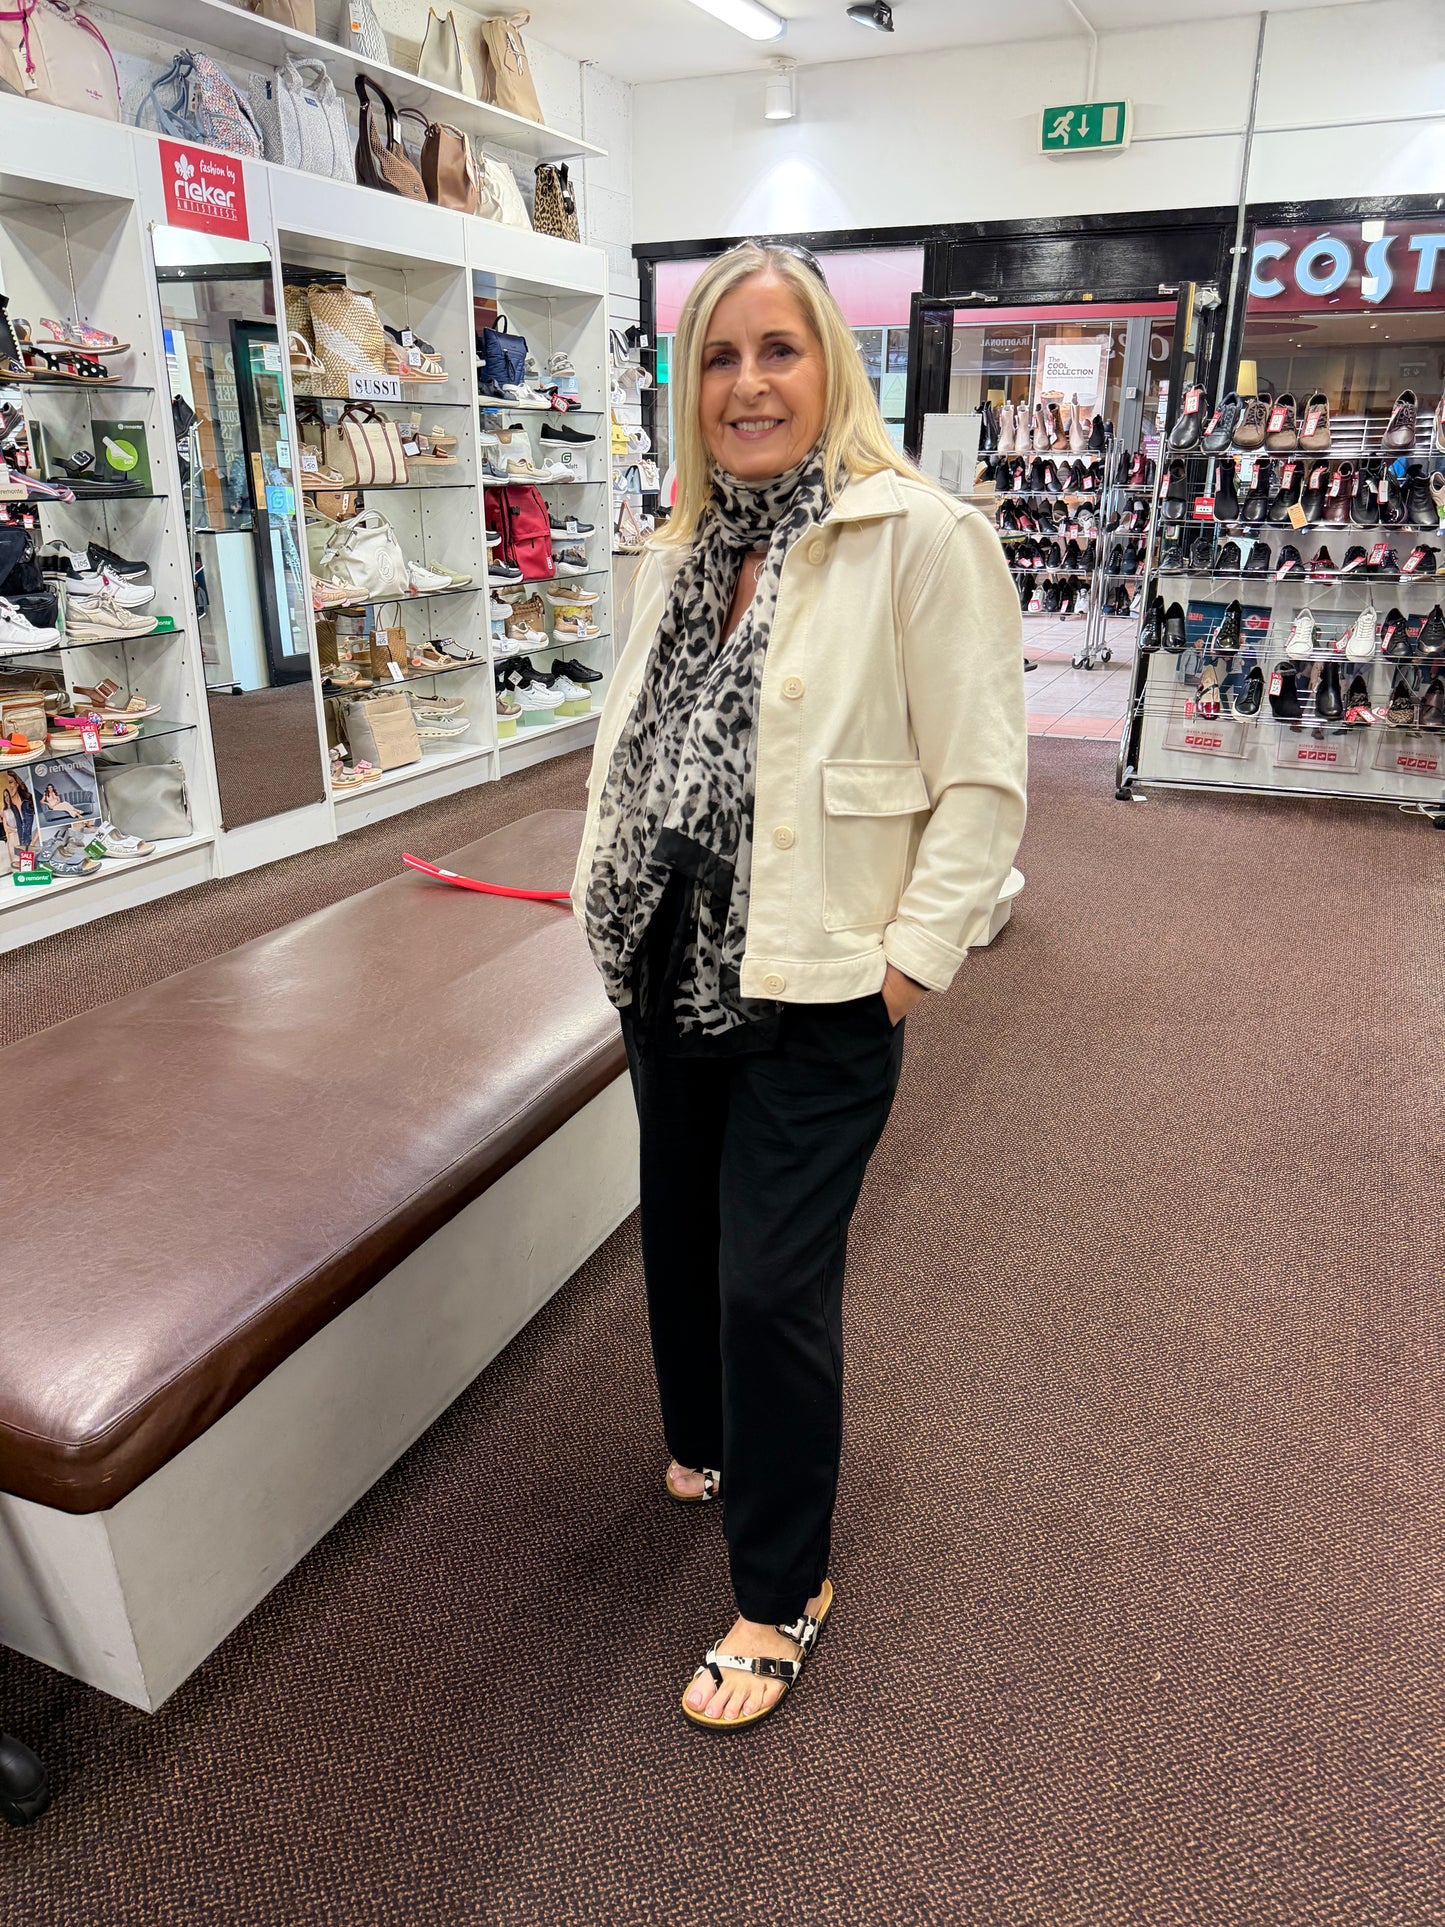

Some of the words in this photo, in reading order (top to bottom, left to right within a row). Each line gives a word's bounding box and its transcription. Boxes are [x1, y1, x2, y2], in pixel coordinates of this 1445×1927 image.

[200, 159, 226, 177] fashion
[226, 165, 236, 185] by
[174, 177, 236, 208] rieker
[177, 199, 236, 219] ANTISTRESS
[355, 379, 398, 396] SUSST
